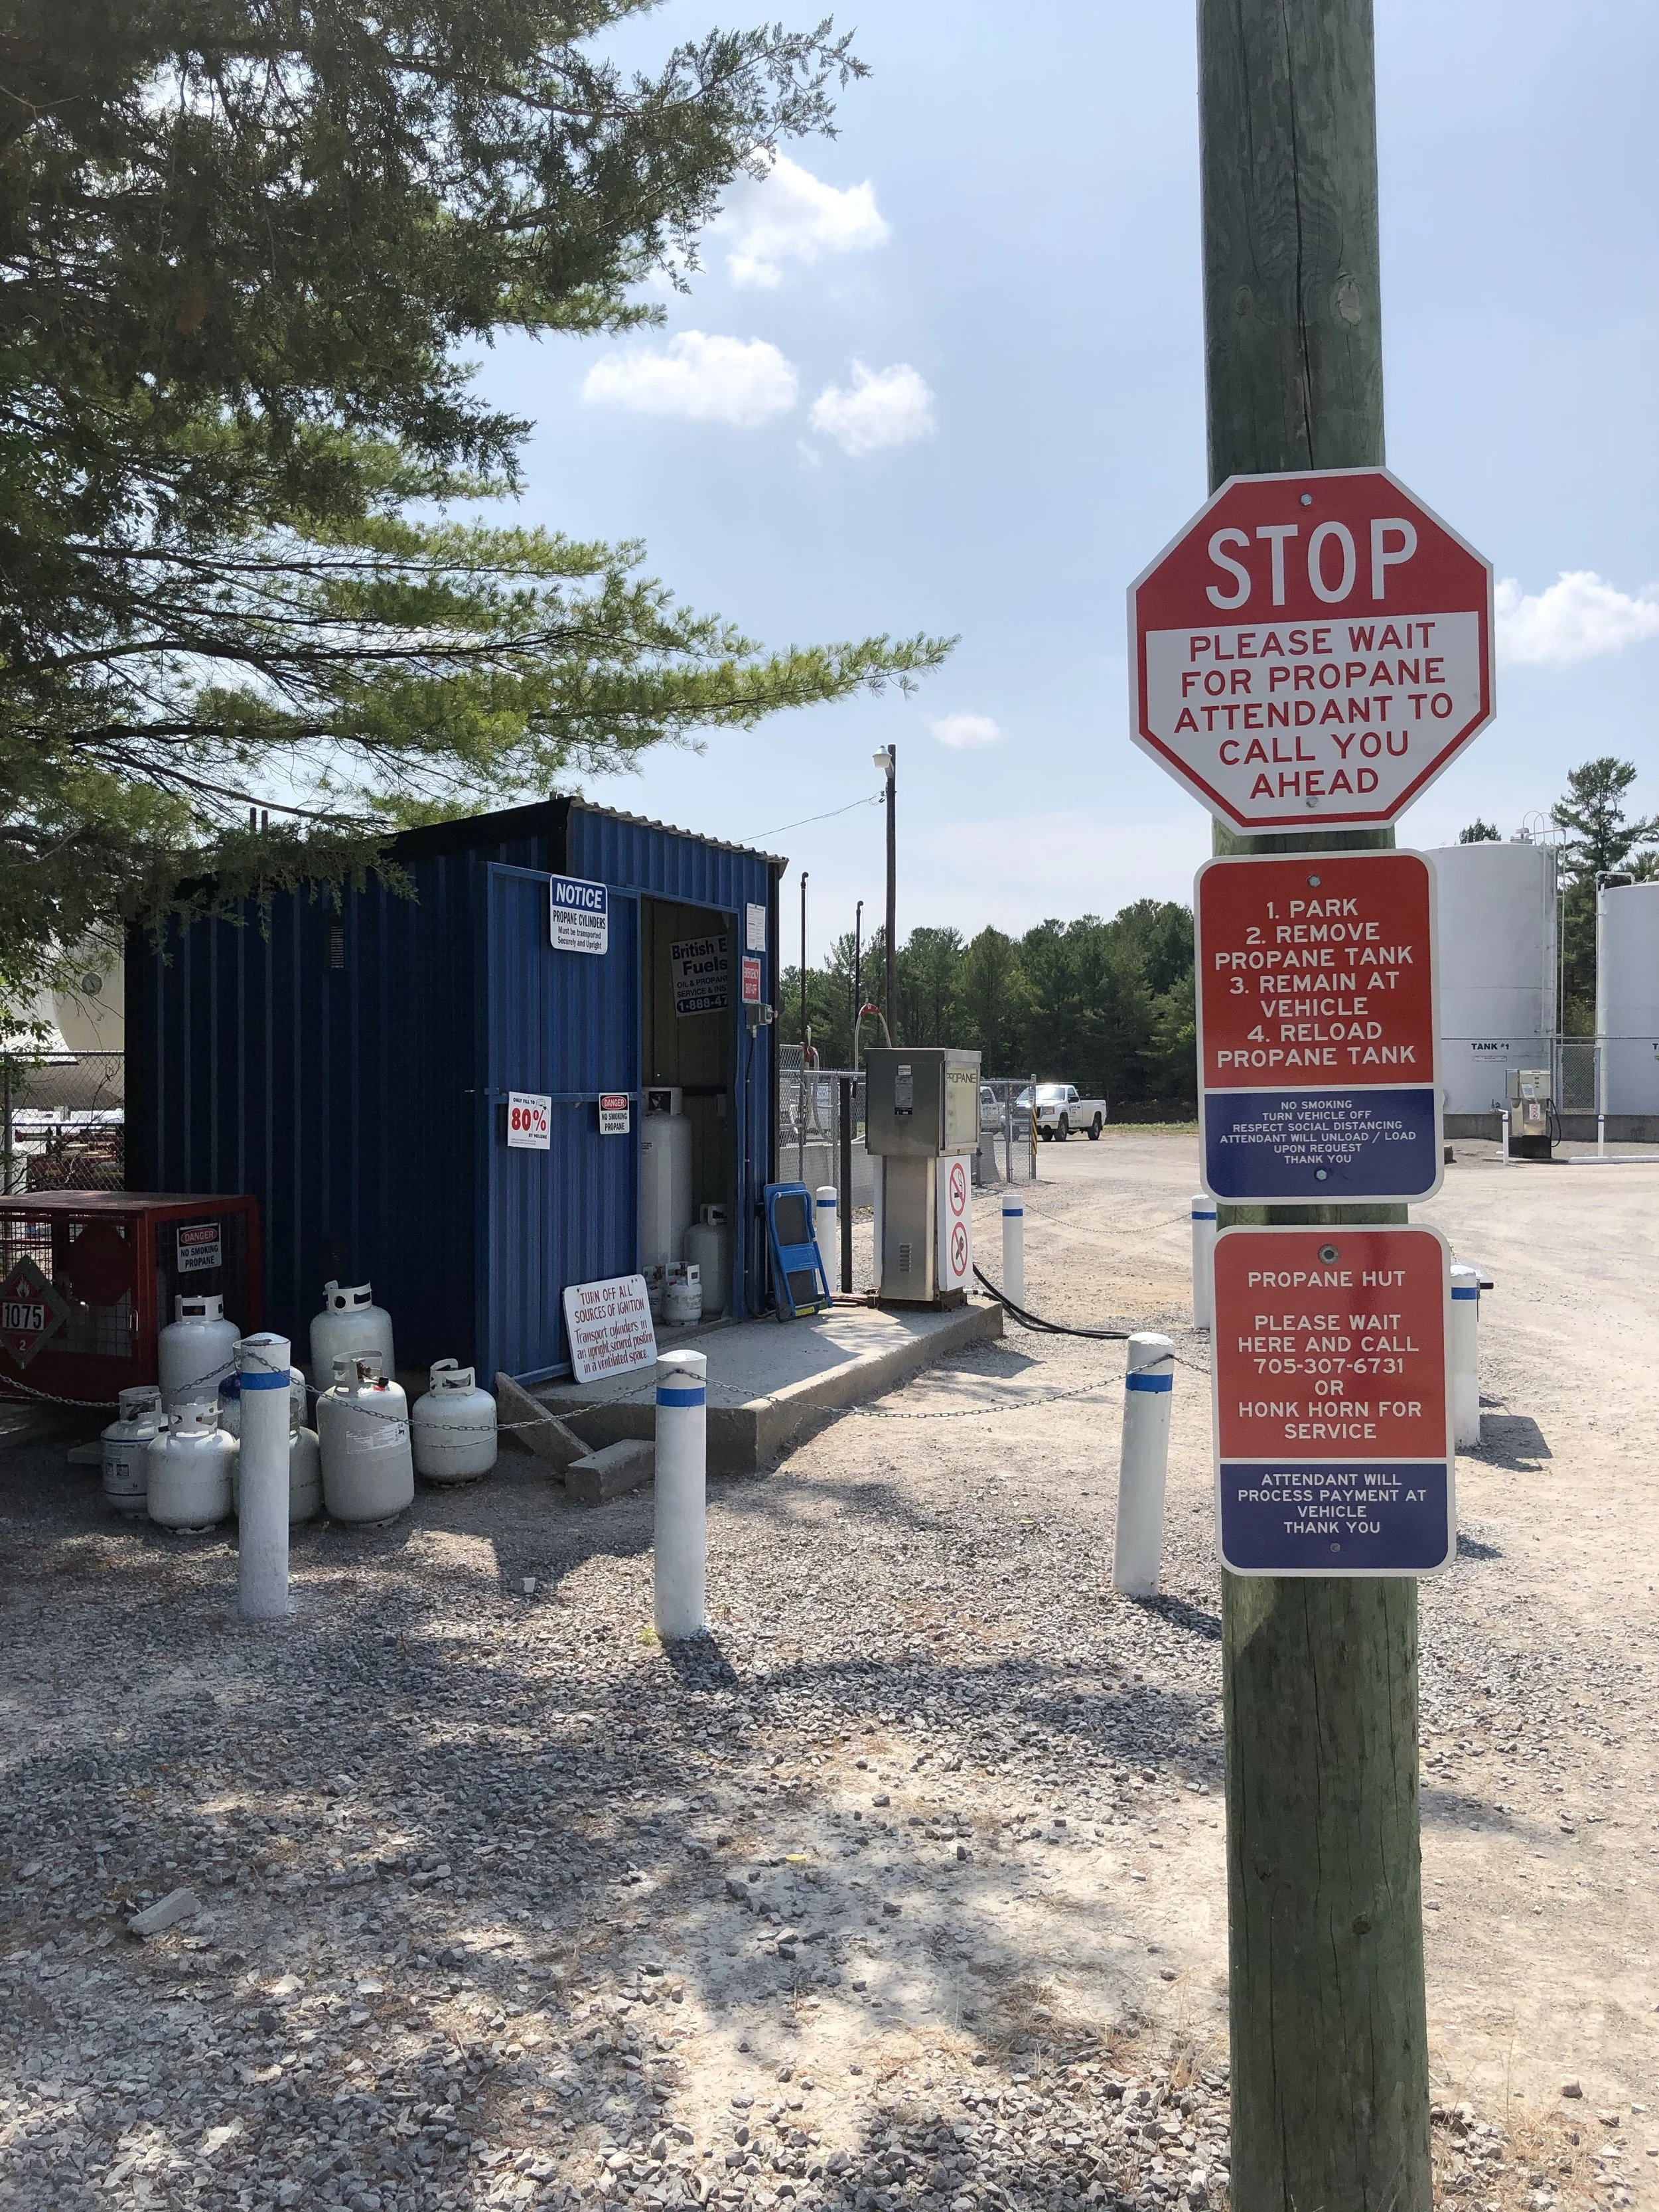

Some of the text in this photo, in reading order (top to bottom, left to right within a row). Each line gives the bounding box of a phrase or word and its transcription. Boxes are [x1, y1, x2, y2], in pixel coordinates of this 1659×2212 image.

[1205, 517, 1418, 610] STOP
[1190, 622, 1435, 662] PLEASE WAIT
[1181, 657, 1445, 698] FOR PROPANE
[1173, 693, 1453, 733] ATTENDANT TO
[1219, 730, 1409, 766] CALL YOU
[1250, 768, 1379, 800] AHEAD
[556, 883, 603, 909] NOTICE
[1266, 898, 1358, 919] 1. PARK
[553, 910, 606, 929] PROPANE CYLINDERS
[558, 926, 569, 934] Must
[577, 928, 601, 939] transported
[1246, 922, 1380, 944] 2. REMOVE
[557, 936, 576, 947] Securely
[586, 940, 601, 950] Upright
[672, 940, 714, 960] British
[683, 956, 728, 976] Fuels
[1215, 946, 1413, 970] PROPANE TANK
[696, 976, 727, 986] PROPAN
[1230, 971, 1400, 994] 3. REMAIN AT
[677, 988, 706, 997] SERVICE
[1260, 997, 1368, 1017] VEHICLE
[1247, 1022, 1382, 1043] 4. RELOAD
[1217, 1046, 1416, 1068] PROPANE TANK
[946, 1073, 976, 1083] PROPANE
[1281, 1100, 1352, 1110] NO SMOKING
[512, 1108, 546, 1131] 80%
[1262, 1110, 1372, 1121] TURN VEHICLE OFF
[1232, 1120, 1402, 1132] RESPECT SOCIAL DISTANCING
[1220, 1133, 1287, 1143] ATTENDANT
[1290, 1133, 1317, 1142] WILL
[1321, 1132, 1369, 1142] UNLOAD
[1384, 1131, 1416, 1140] LOAD
[1273, 1143, 1362, 1153] UPON REQUEST
[1284, 1154, 1352, 1163] THANK YOU
[185, 1230, 213, 1242] DANGER
[191, 1245, 218, 1256] SMOKING
[185, 1256, 214, 1268] PROPANE
[1248, 1270, 1406, 1288] PROPANE HUT
[581, 1285, 632, 1305] TURN OFF ALL
[5, 1304, 41, 1329] 1075
[575, 1298, 645, 1324] SOURCES OF IGNITION
[574, 1316, 648, 1345] Transport cylinders in
[1255, 1314, 1401, 1331] PLEASE WAIT
[19, 1340, 26, 1351] 2
[577, 1349, 586, 1360] an
[633, 1331, 653, 1350] position
[1238, 1335, 1419, 1353] HERE AND CALL
[583, 1360, 591, 1373] in
[592, 1363, 597, 1371] a
[598, 1349, 628, 1370] ventilated
[1254, 1358, 1404, 1374] 705-307-6731
[1314, 1380, 1344, 1396] OR
[1238, 1401, 1422, 1418] HONK HORN FOR
[1284, 1423, 1377, 1439] SERVICE
[1262, 1473, 1402, 1486] ATTENDANT WILL
[1238, 1489, 1426, 1502] PROCESS PAYMENT AT
[1297, 1505, 1367, 1518] VEHICLE
[1284, 1522, 1380, 1534] THANK YOU
